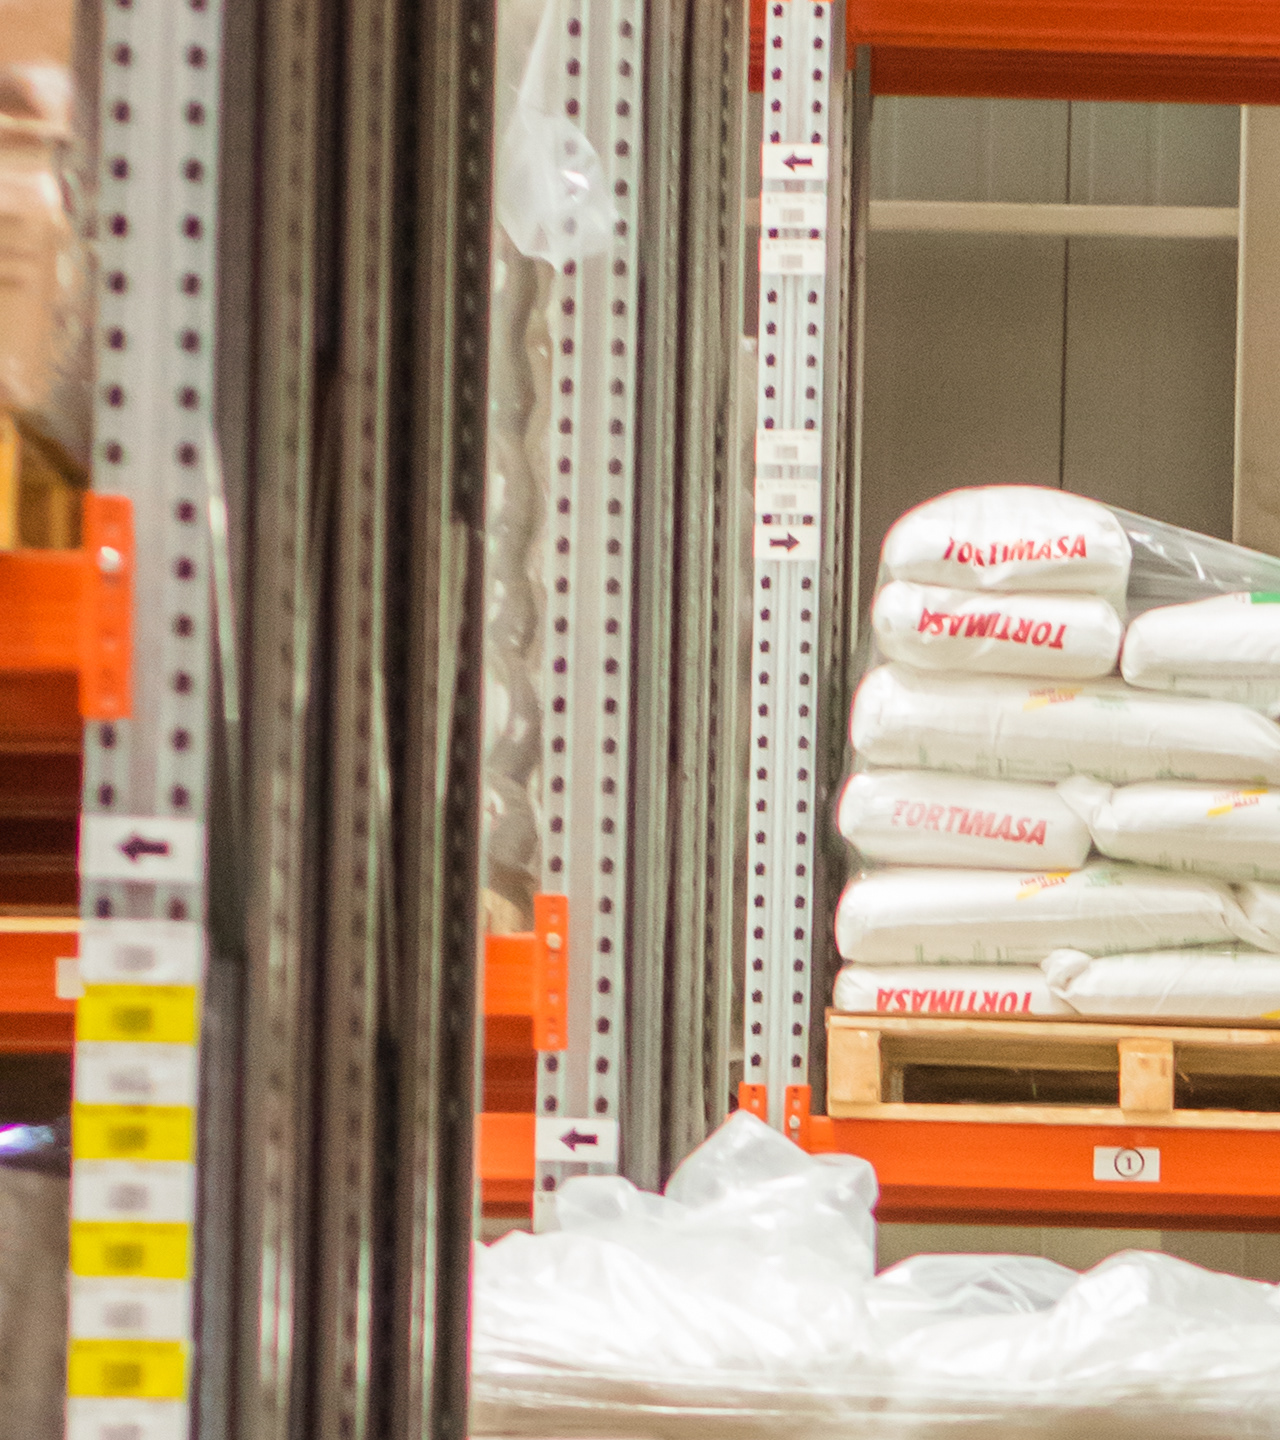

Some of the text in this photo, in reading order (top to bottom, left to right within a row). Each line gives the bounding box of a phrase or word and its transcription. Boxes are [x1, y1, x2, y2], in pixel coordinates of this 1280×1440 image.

[942, 533, 1088, 568] TORTIMASA
[916, 607, 1068, 650] TORTIMASA
[891, 799, 1048, 847] TORTIMASA
[876, 987, 1033, 1014] TORTIMASA
